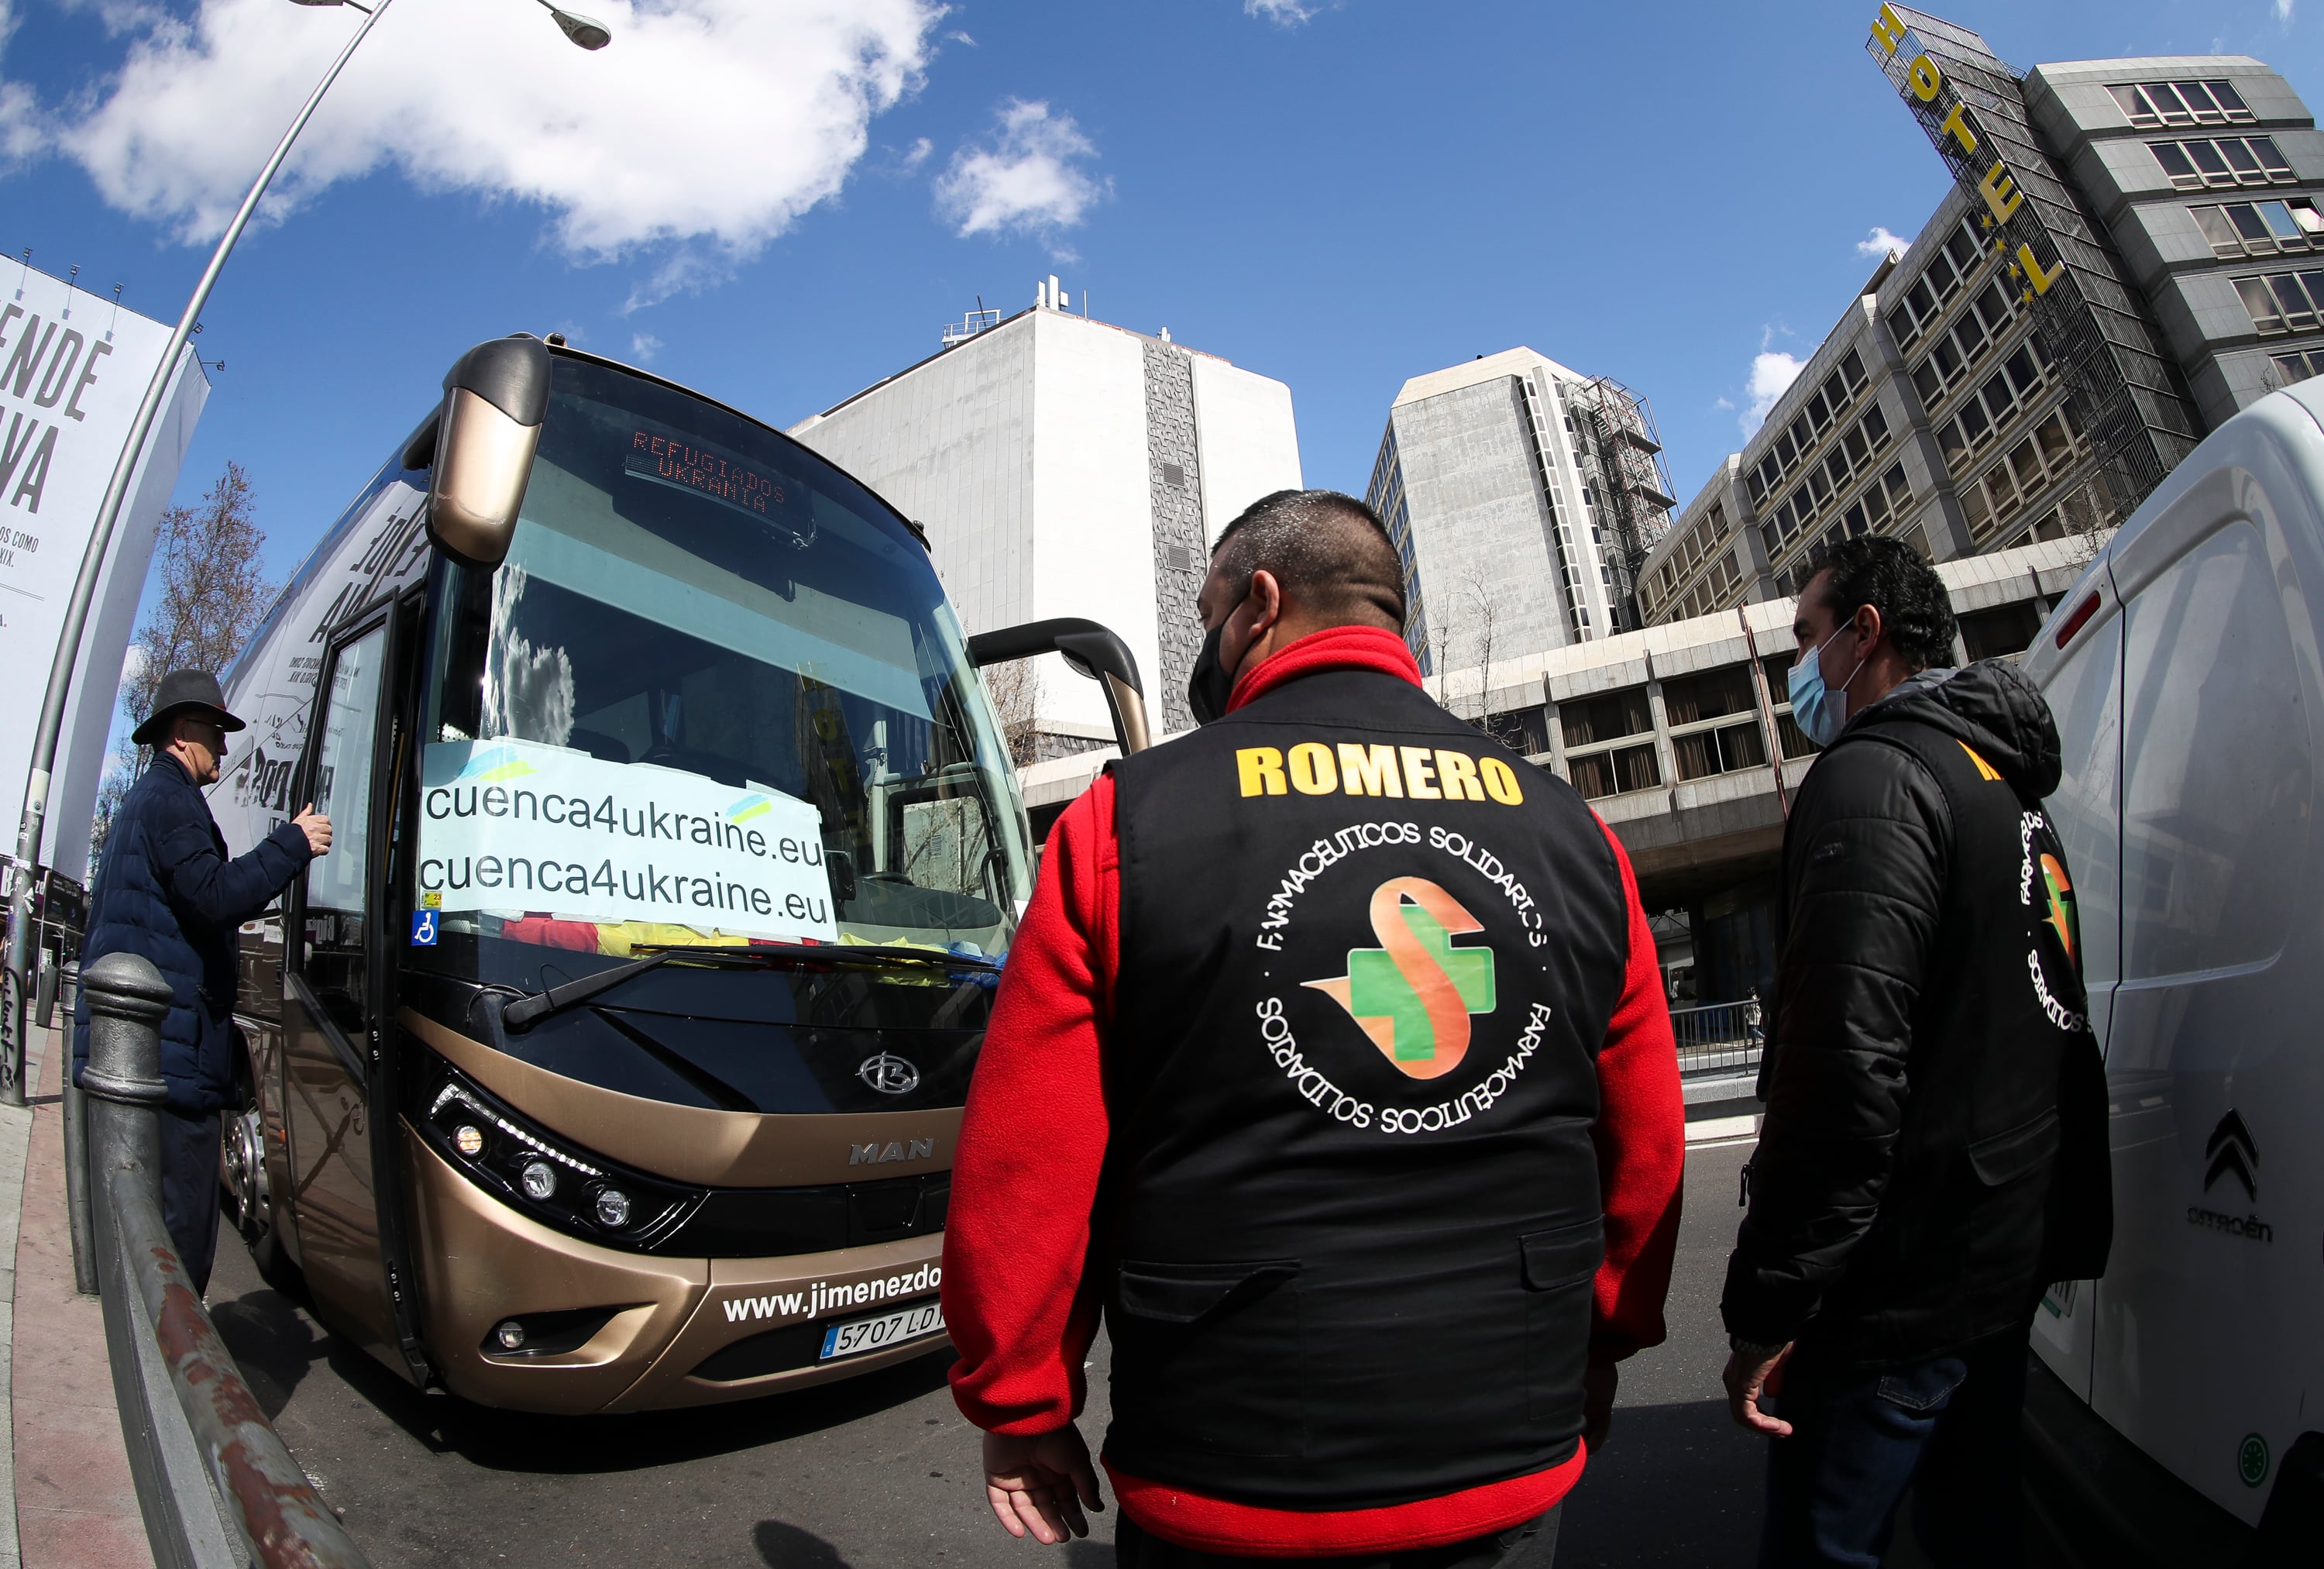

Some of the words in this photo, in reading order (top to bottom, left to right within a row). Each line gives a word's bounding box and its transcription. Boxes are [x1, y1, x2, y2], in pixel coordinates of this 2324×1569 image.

[1869, 2, 2066, 297] HOTEL
[633, 431, 786, 504] REFUGIADOS
[658, 457, 766, 514] UKRANIA
[12, 531, 40, 552] COMO
[1236, 741, 1525, 806] ROMERO
[425, 785, 823, 867] cuenca4ukraine.eu
[420, 855, 827, 924] cuenca4ukraine.eu
[848, 1137, 934, 1166] MAN
[723, 1263, 942, 1323] www.jimenezdo
[838, 1316, 903, 1351] 5707
